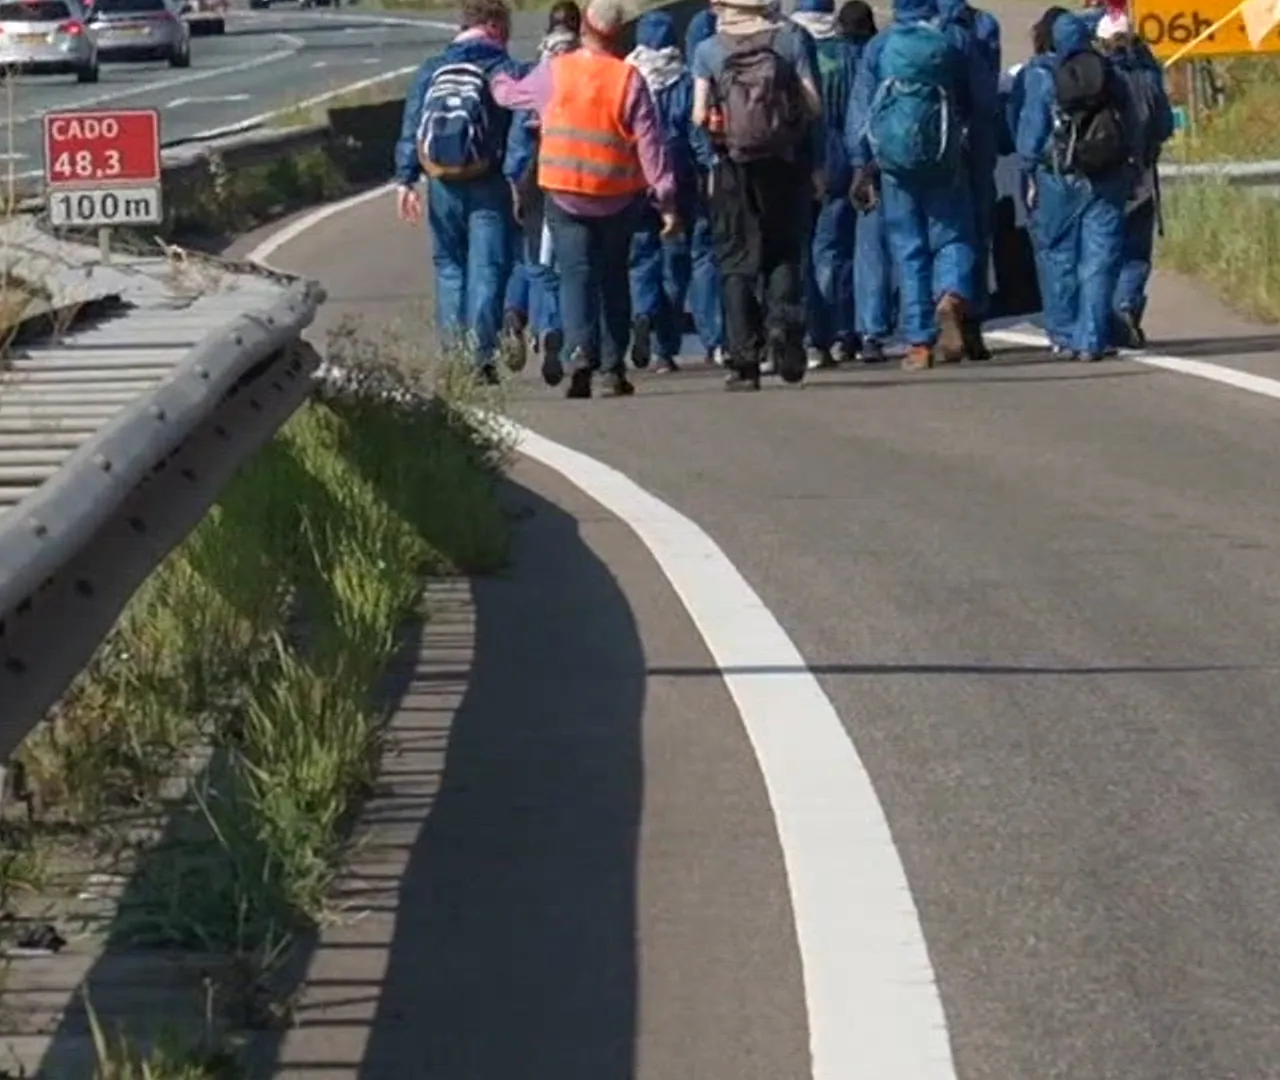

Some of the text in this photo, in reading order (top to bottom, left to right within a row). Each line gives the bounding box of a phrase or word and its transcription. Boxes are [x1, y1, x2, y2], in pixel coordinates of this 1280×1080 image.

[1139, 12, 1216, 45] 06h
[52, 118, 119, 141] CADO
[59, 192, 150, 220] 100m
